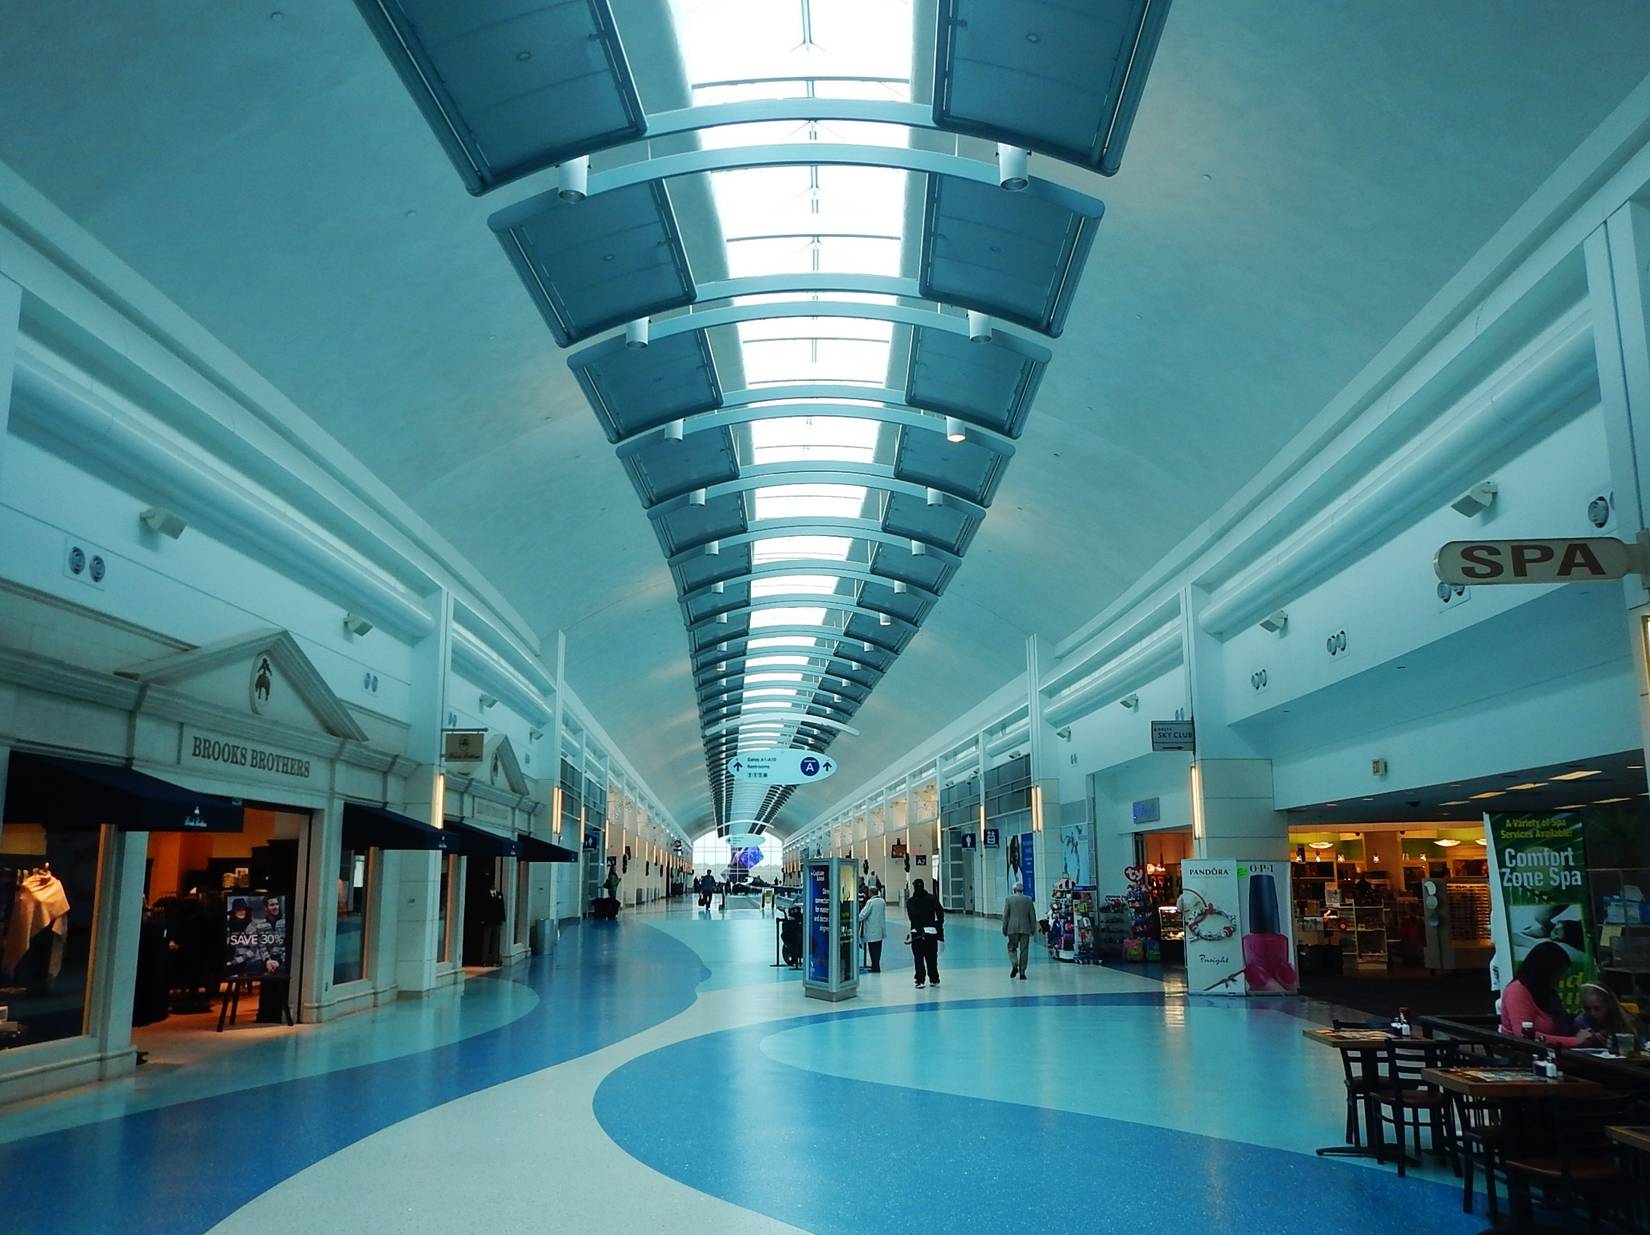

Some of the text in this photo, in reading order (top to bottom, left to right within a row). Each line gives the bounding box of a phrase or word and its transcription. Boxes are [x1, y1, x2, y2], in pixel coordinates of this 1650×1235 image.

[1460, 543, 1606, 579] SPA
[192, 736, 311, 779] BROOKS BROTHERS
[805, 763, 814, 772] A
[1501, 830, 1533, 838] Services
[1504, 847, 1575, 867] Comfort
[1501, 867, 1582, 890] Zone Spa
[230, 934, 284, 945] SAVE 30%
